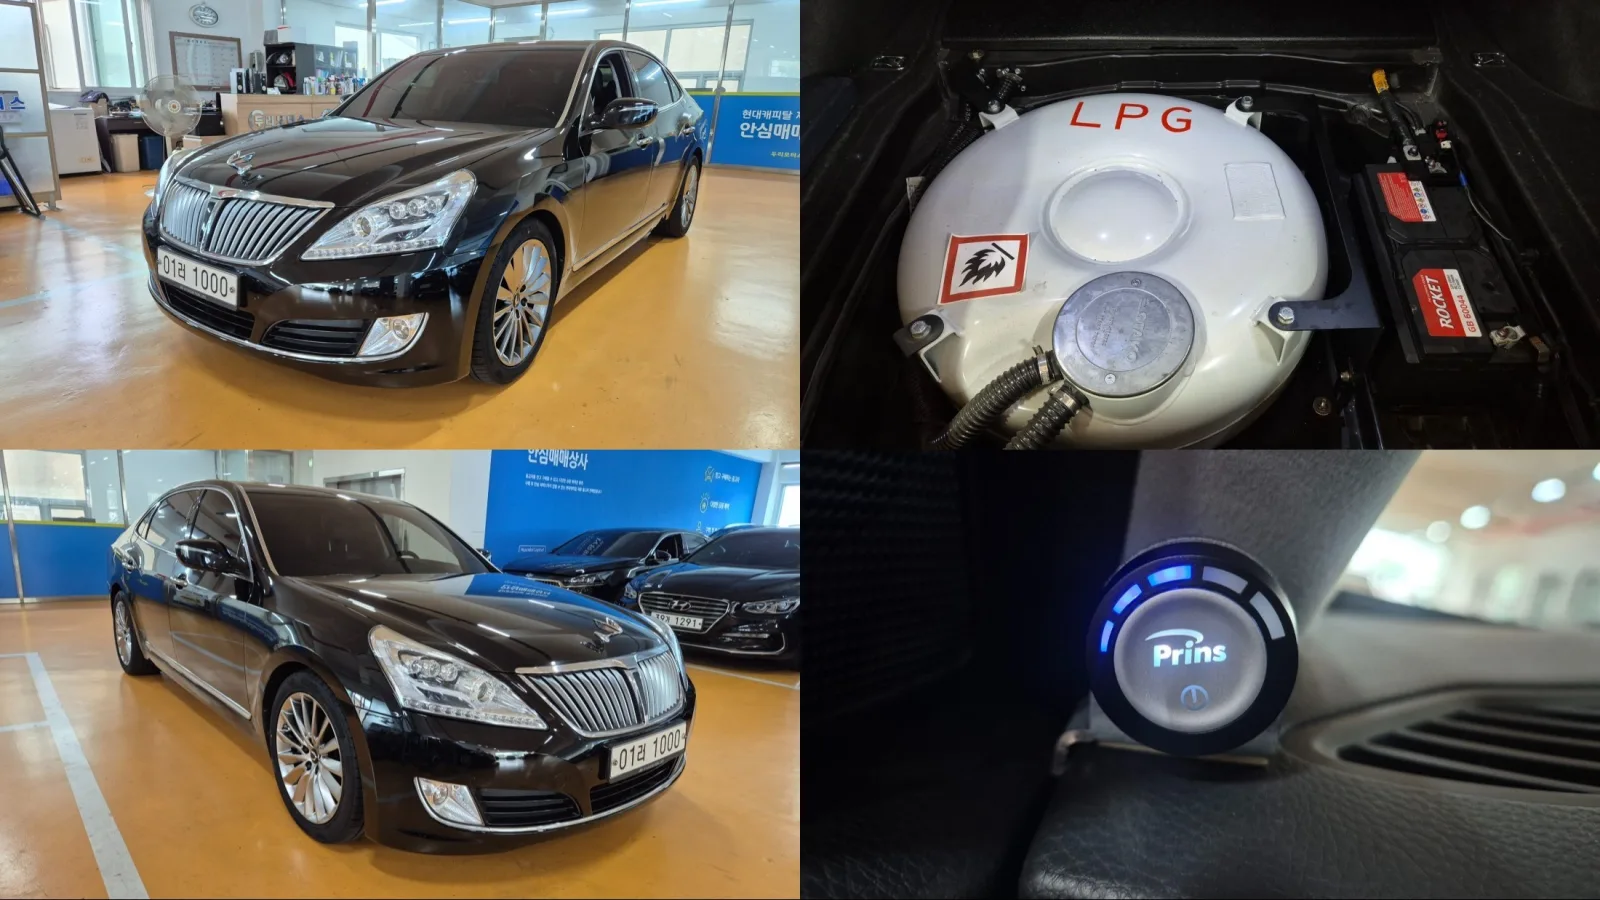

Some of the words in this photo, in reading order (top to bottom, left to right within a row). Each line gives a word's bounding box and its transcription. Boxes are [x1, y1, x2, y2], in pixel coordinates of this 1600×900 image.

[0, 96, 26, 110] 스
[742, 109, 793, 120] 현대캐피탈
[1069, 101, 1192, 133] LPG
[163, 255, 186, 281] 01러
[193, 266, 228, 297] 1000
[1425, 275, 1455, 329] ROCKET
[1457, 294, 1472, 319] 60044
[1466, 320, 1477, 333] GB
[527, 450, 589, 471] 안심매매상사
[675, 616, 698, 628] 1291
[1153, 640, 1227, 668] Prins
[619, 743, 646, 770] 01러
[653, 729, 681, 758] 1000
